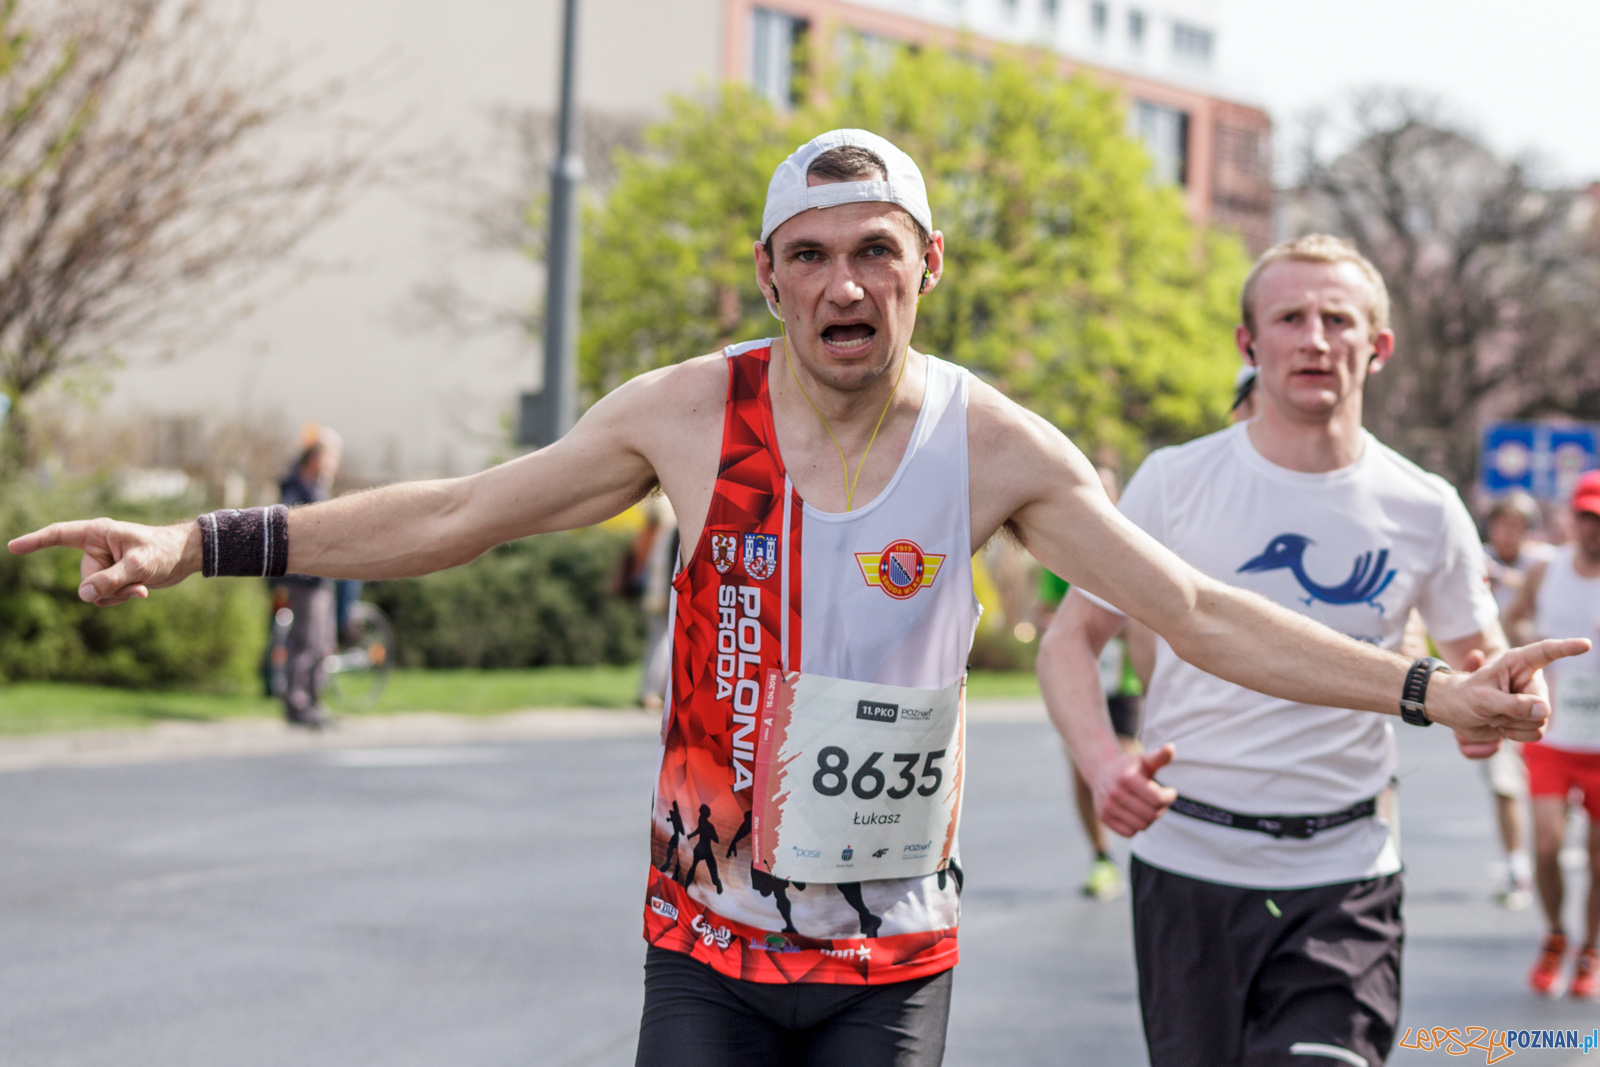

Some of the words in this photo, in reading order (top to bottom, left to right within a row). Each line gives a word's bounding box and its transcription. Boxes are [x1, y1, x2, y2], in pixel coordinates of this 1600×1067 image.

[716, 584, 744, 701] ŚRODA
[732, 585, 761, 792] POLONIA
[766, 674, 777, 708] 15.04.2018
[763, 718, 774, 726] A
[863, 705, 873, 715] 11.
[874, 707, 895, 718] PKO
[812, 745, 947, 800] 8635
[853, 811, 901, 826] Łukasz
